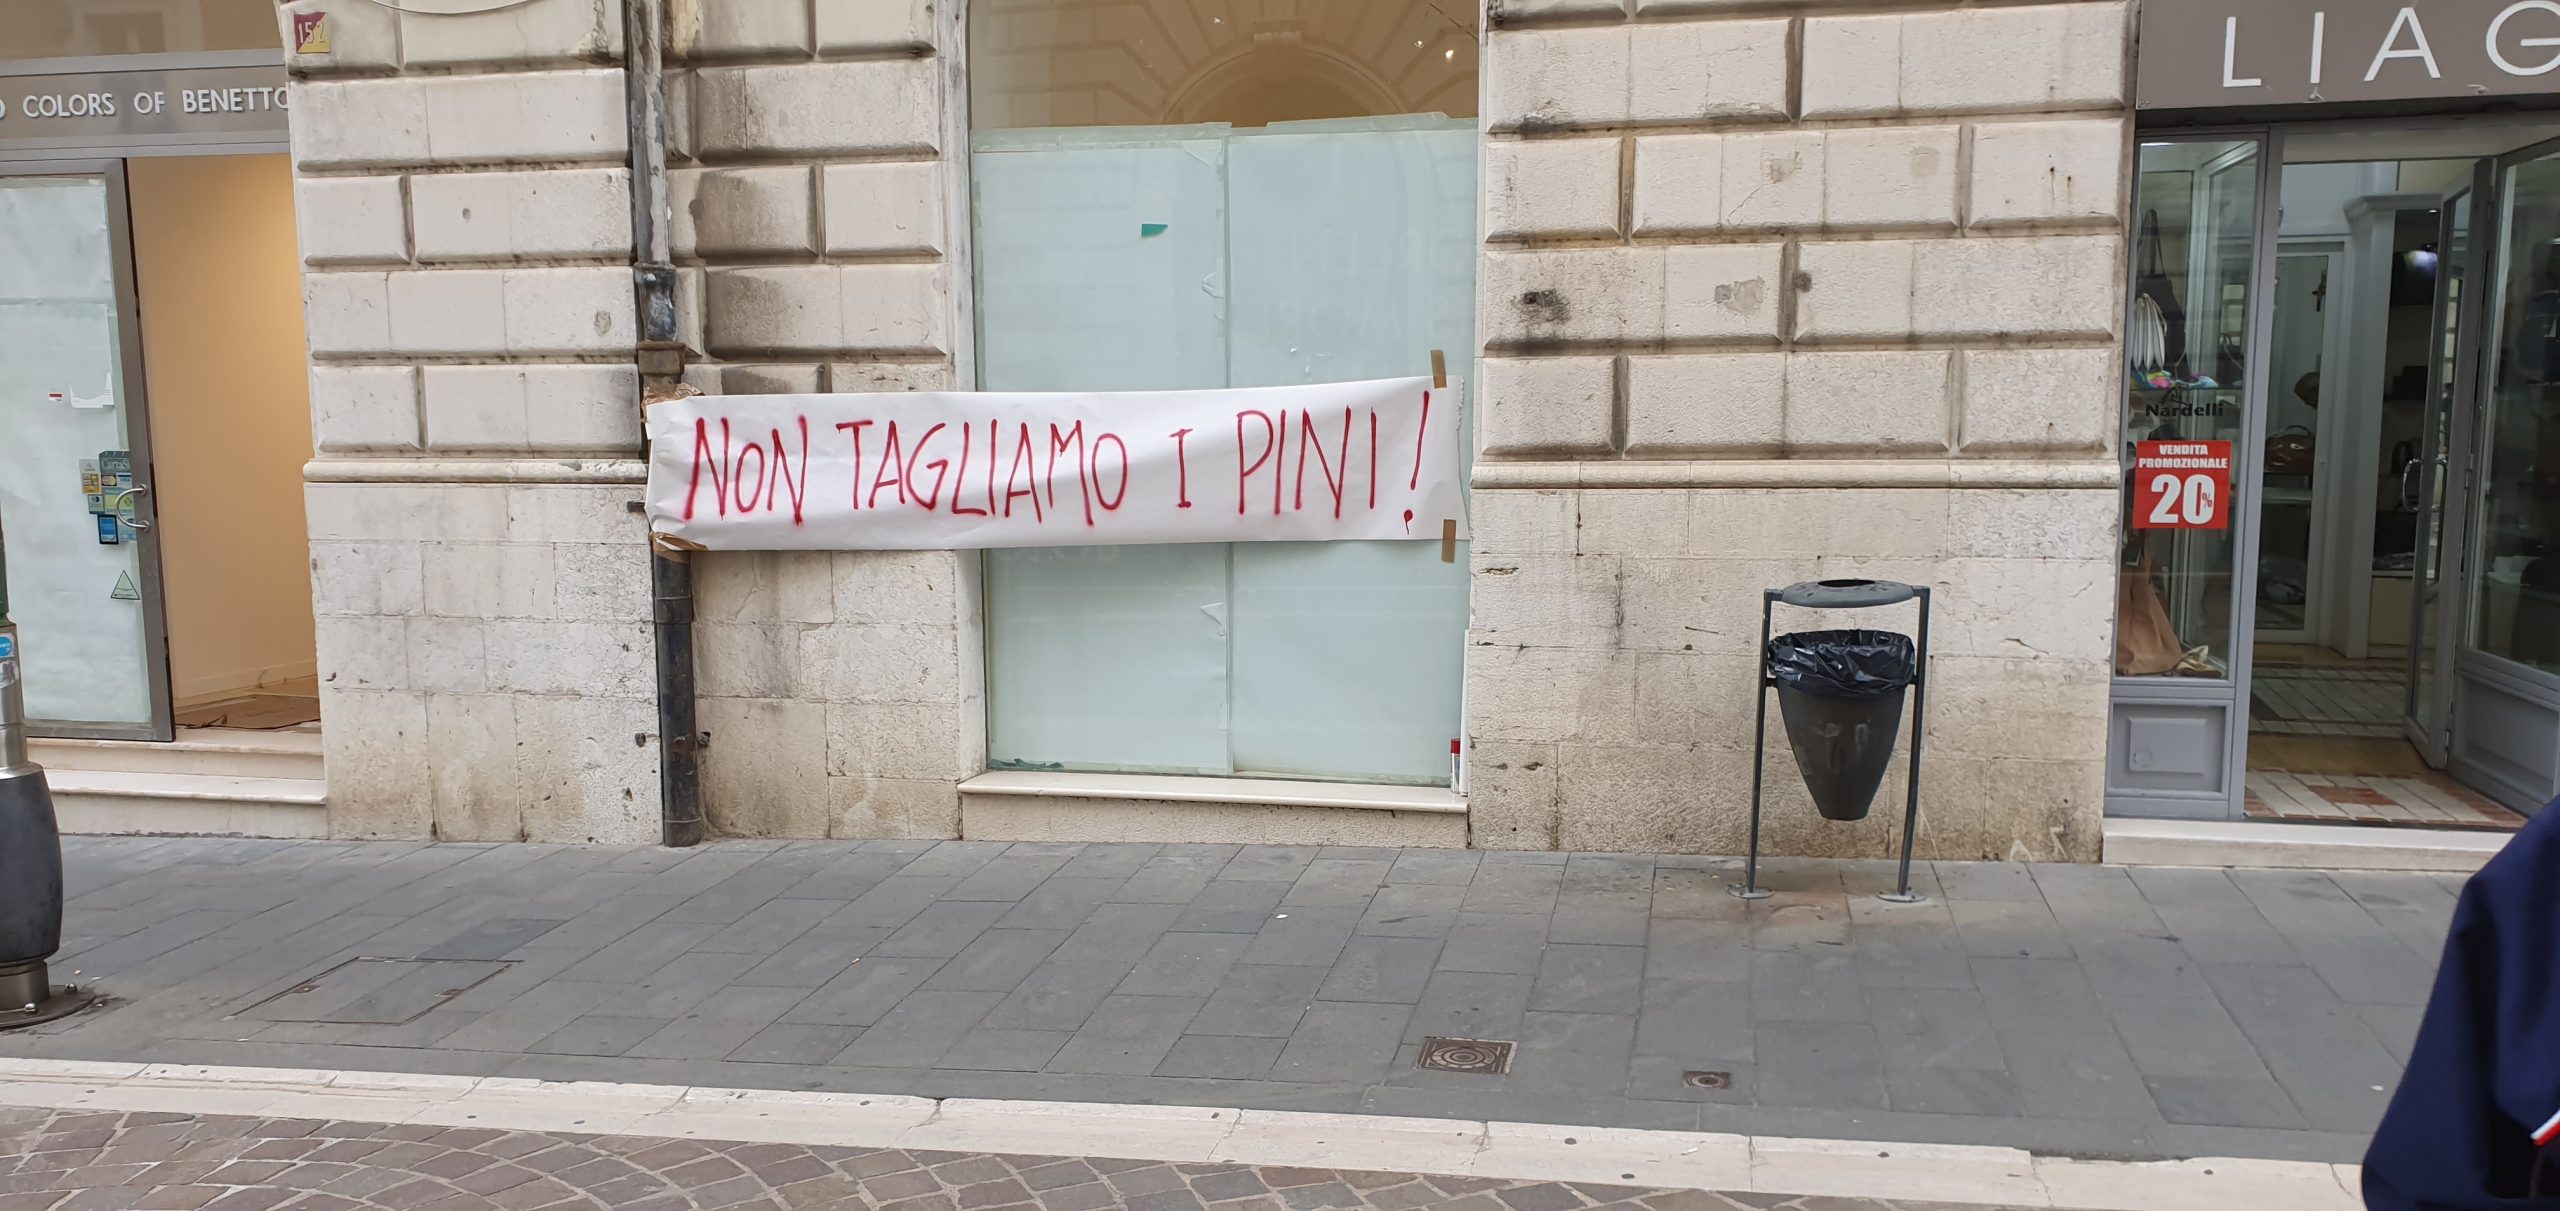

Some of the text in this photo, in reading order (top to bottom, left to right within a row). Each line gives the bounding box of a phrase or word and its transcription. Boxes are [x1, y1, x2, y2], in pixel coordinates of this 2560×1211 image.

[298, 21, 325, 44] 152
[22, 92, 116, 119] COLORS
[133, 91, 165, 114] OF
[2145, 402, 2224, 417] Nardelli
[2159, 444, 2208, 456] VENDITA
[683, 414, 808, 527] NON
[835, 418, 1128, 527] TAGLIAMO
[1168, 427, 1193, 509] I
[2138, 457, 2228, 469] PROMOZIONALE
